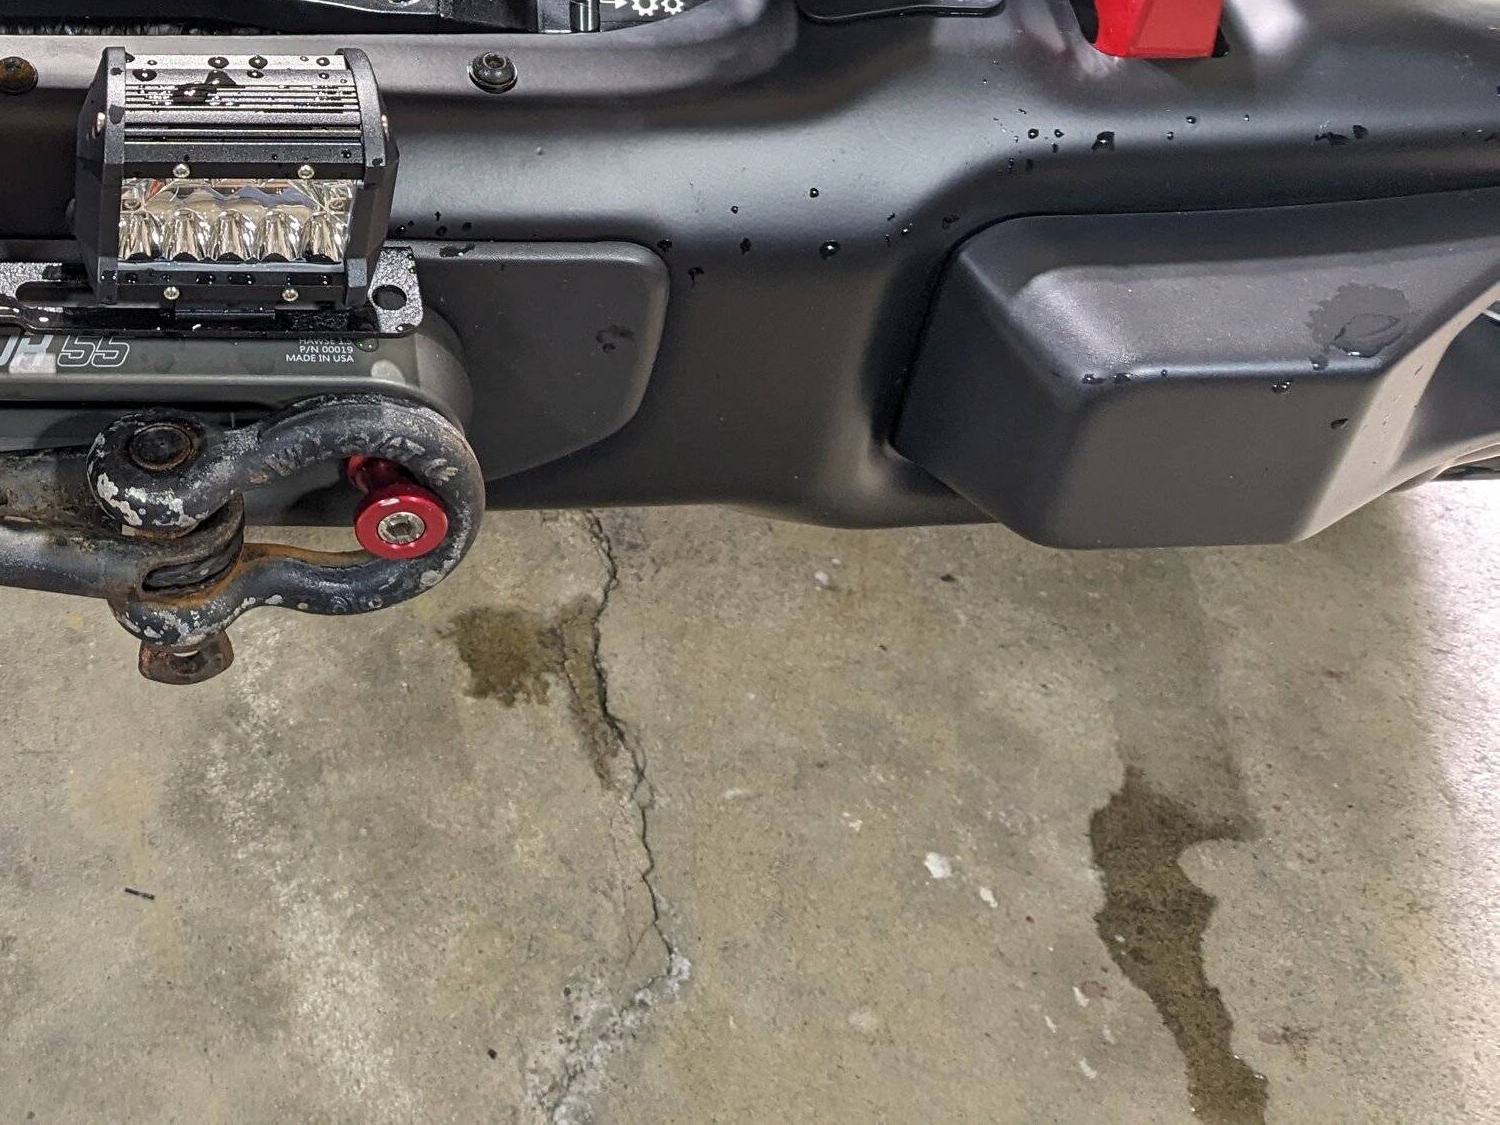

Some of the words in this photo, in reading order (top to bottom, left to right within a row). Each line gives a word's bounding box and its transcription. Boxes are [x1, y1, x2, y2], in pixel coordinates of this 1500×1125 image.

[57, 334, 130, 367] 55
[299, 345, 319, 354] P/N
[321, 345, 354, 354] 00019
[285, 354, 316, 362] MADE
[318, 354, 330, 362] IN
[333, 354, 354, 362] USA
